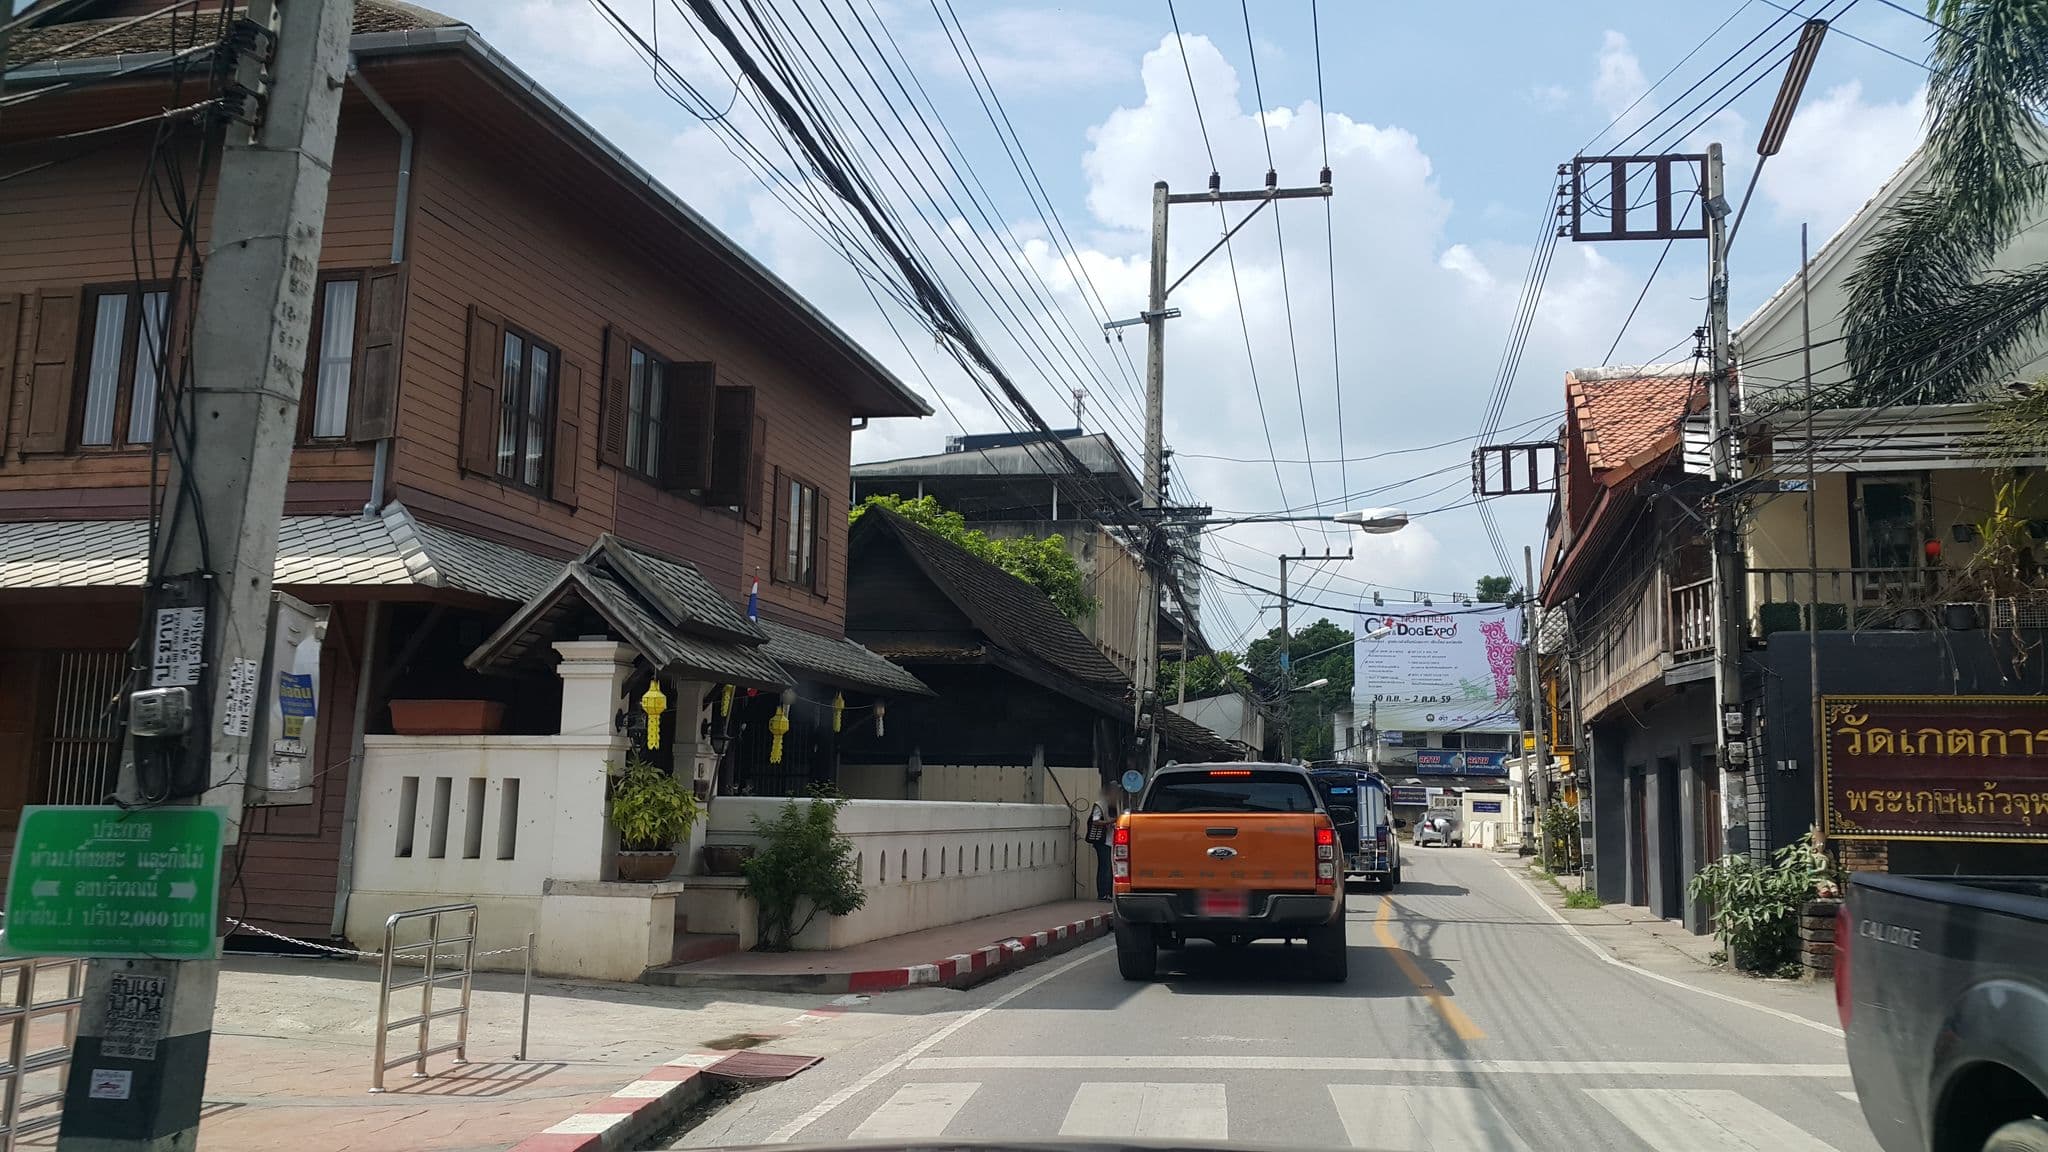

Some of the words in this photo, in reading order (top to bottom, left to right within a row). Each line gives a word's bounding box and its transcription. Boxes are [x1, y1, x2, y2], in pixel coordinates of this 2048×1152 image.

[1401, 615, 1454, 623] NORTHERN
[155, 613, 173, 681] ปะยาง
[1373, 694, 1383, 702] 30
[1441, 695, 1451, 703] 59
[1860, 919, 1922, 949] CALIBRE
